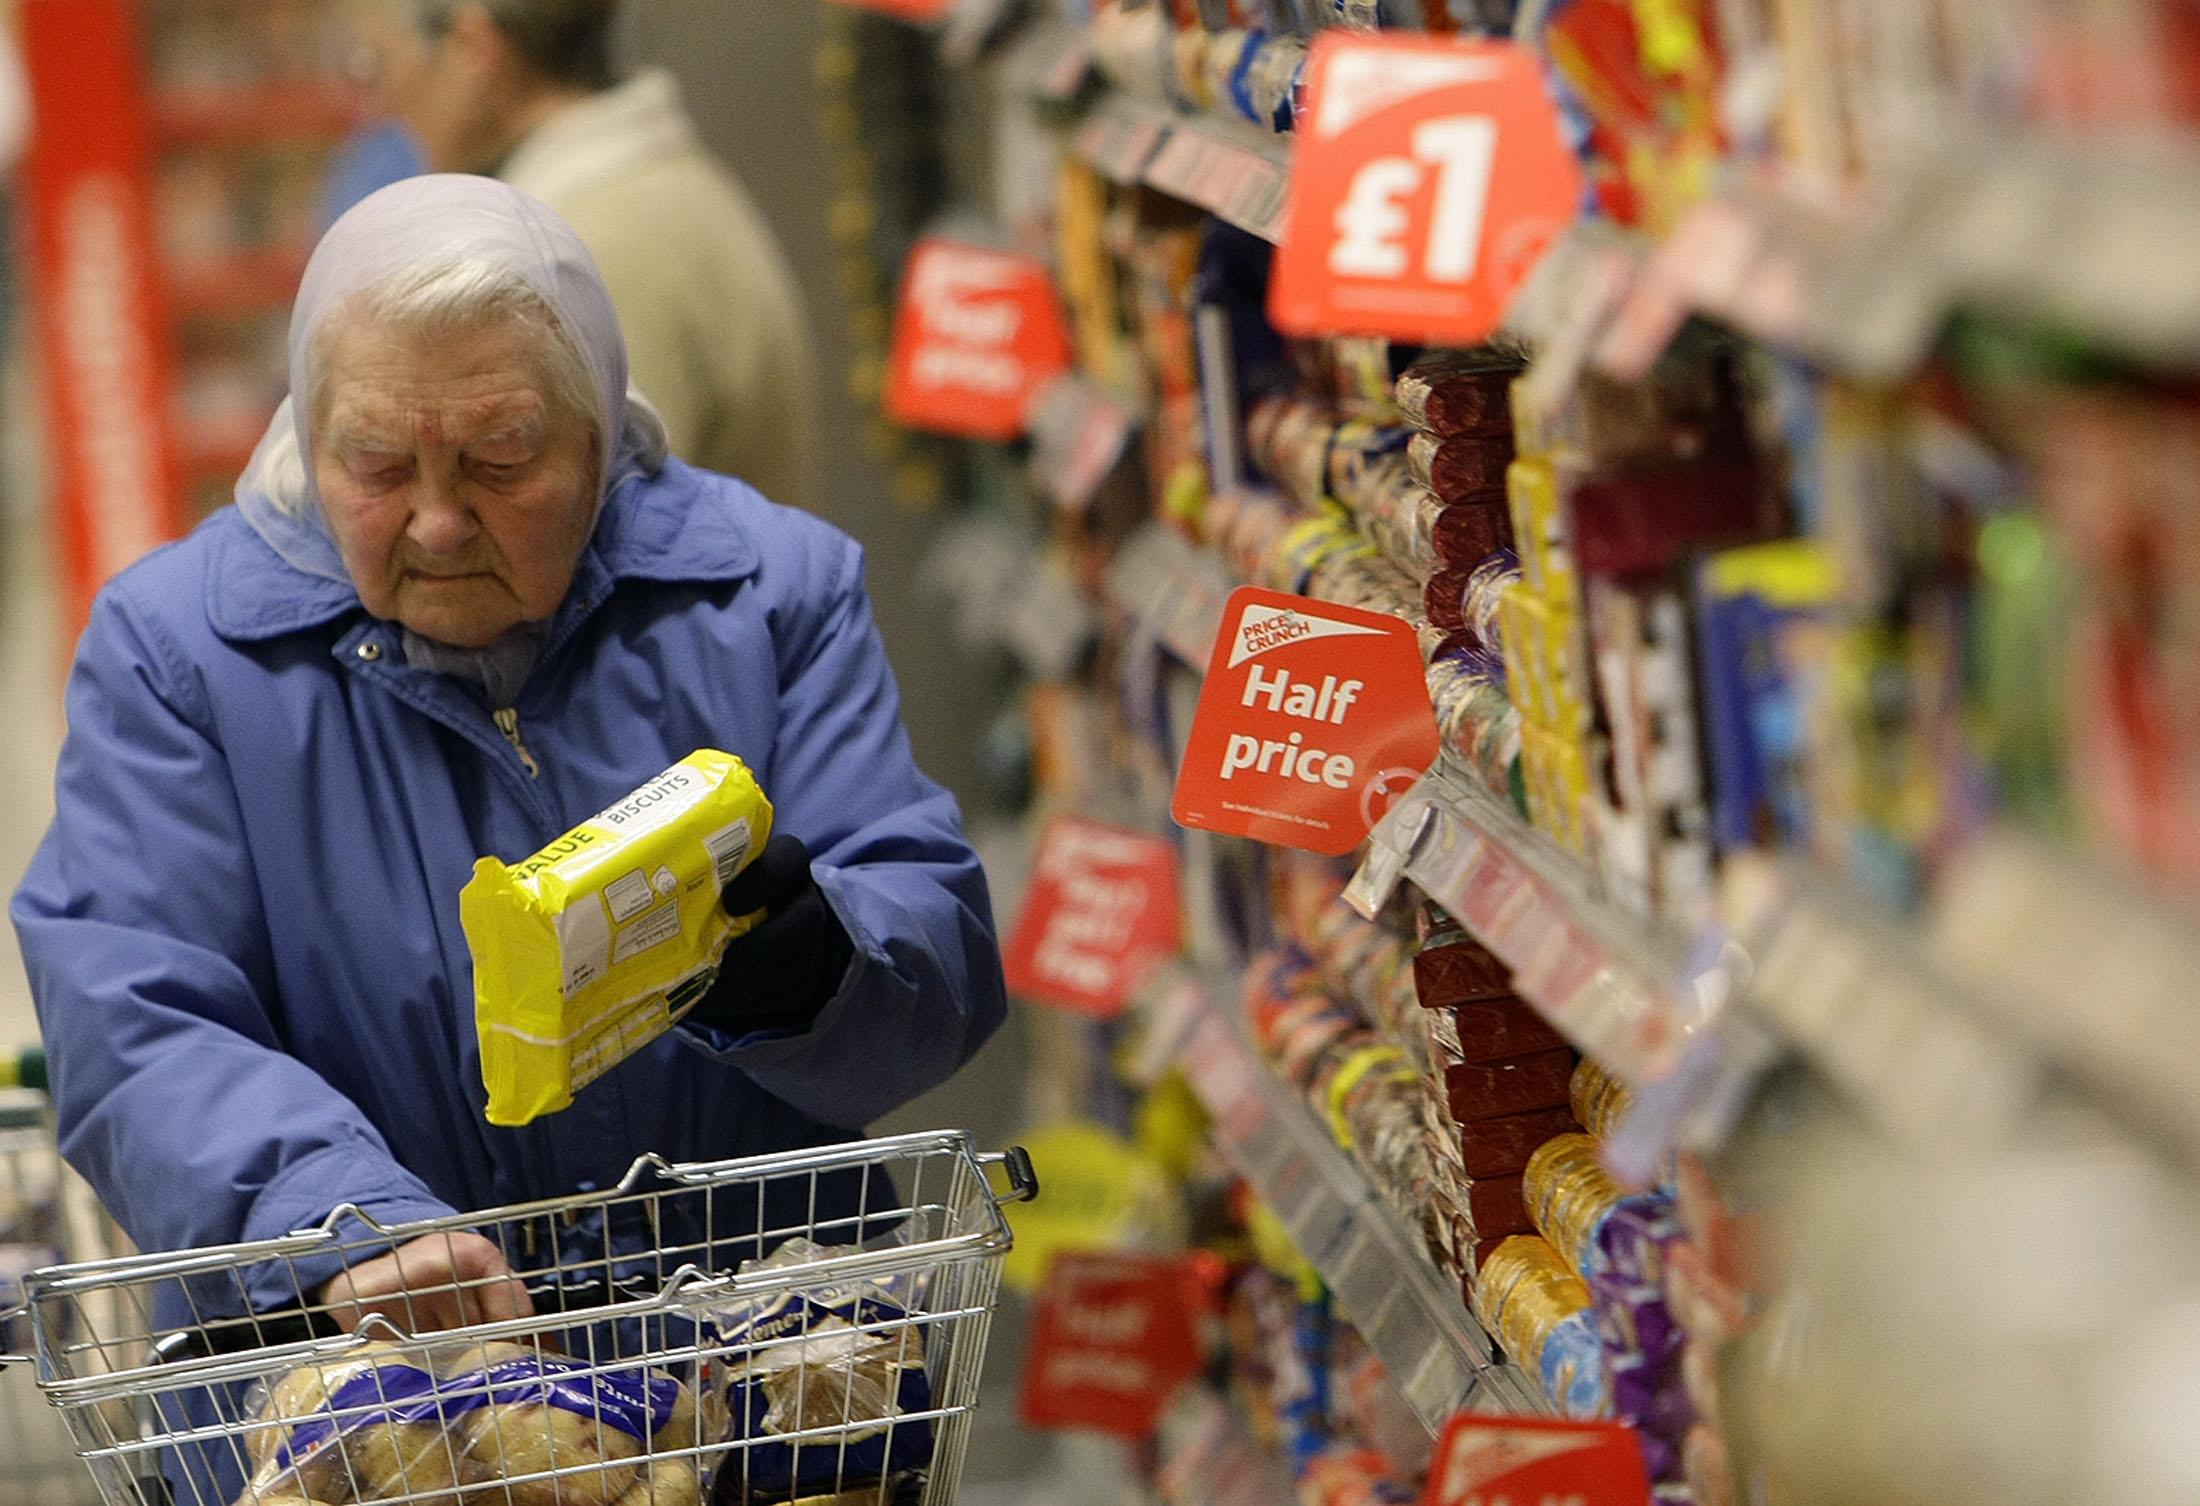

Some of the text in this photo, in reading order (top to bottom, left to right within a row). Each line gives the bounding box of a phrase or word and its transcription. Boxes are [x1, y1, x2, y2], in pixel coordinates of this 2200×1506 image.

[1328, 115, 1498, 284] £1
[1242, 614, 1288, 641] PRICE
[1246, 621, 1312, 653] CRUNCH
[1241, 663, 1364, 725] Half
[1220, 731, 1355, 789] price
[607, 775, 690, 824] BISCUITS
